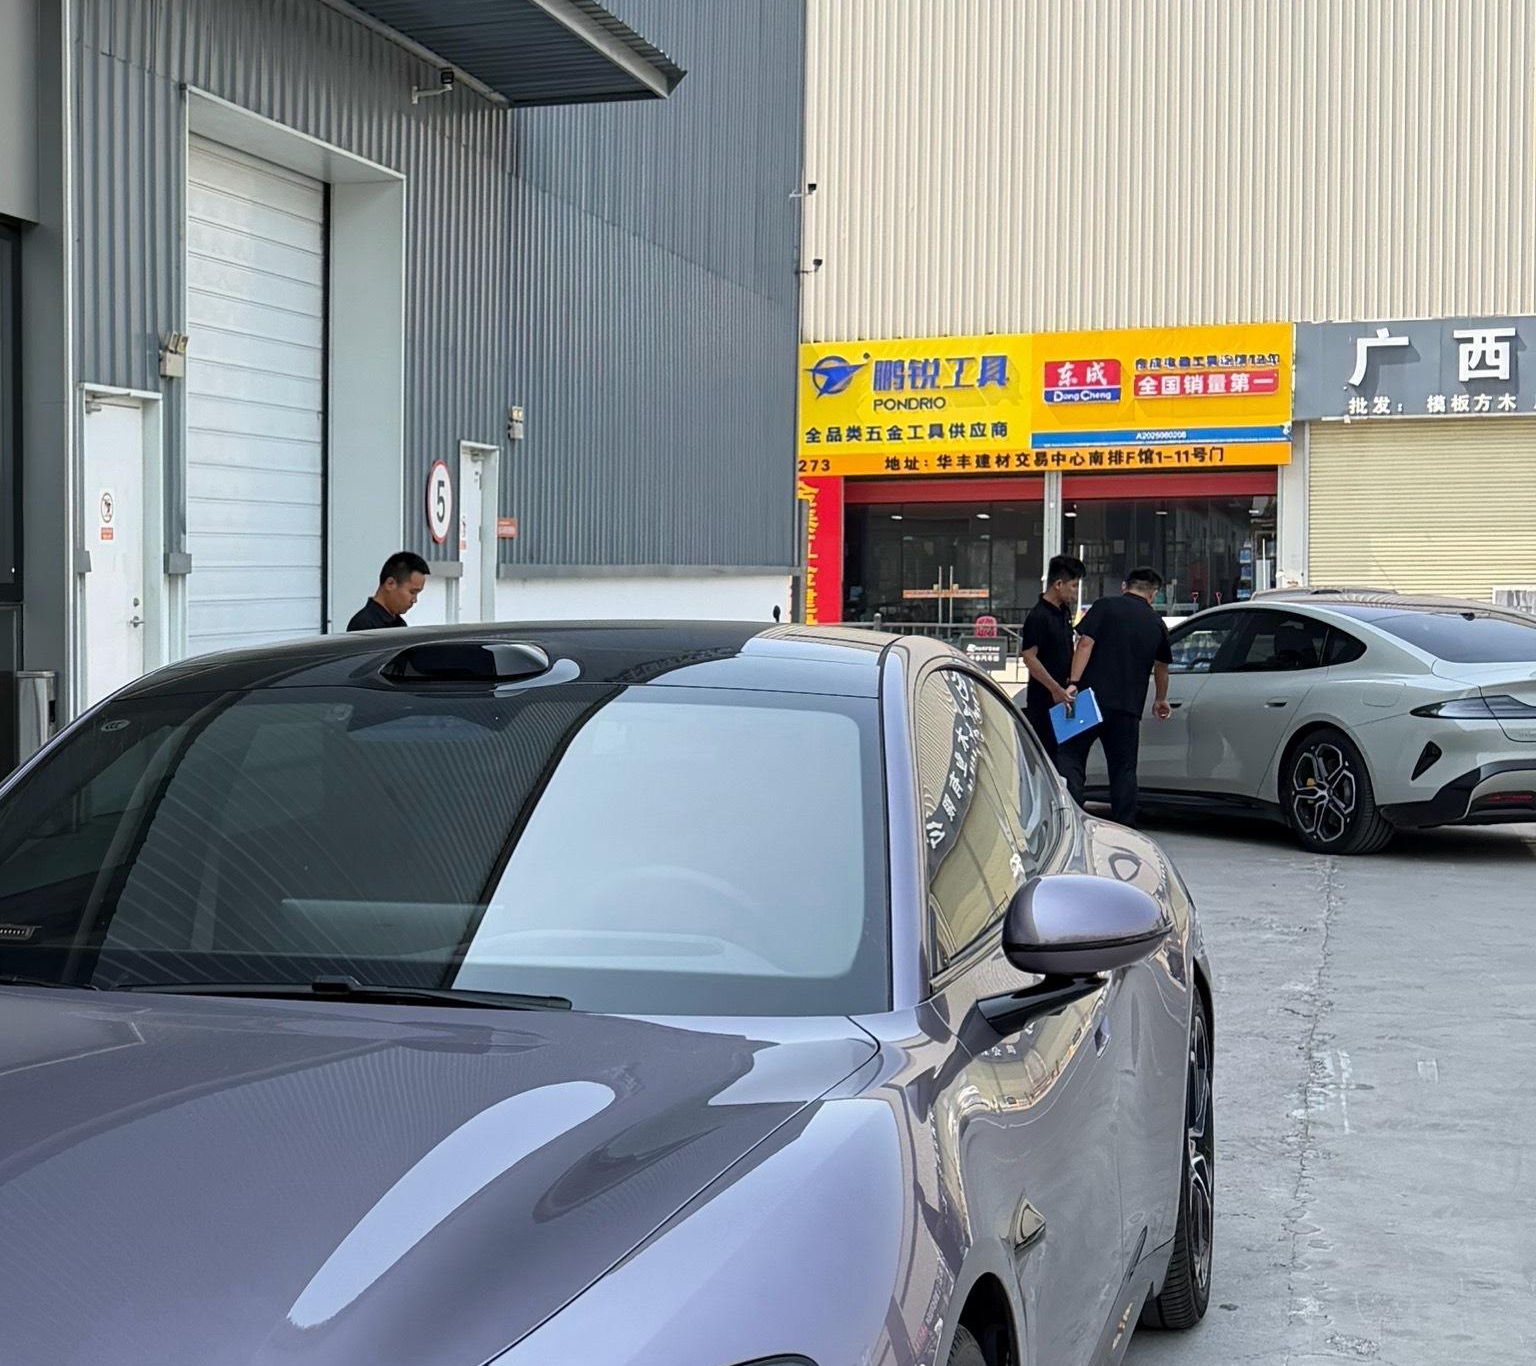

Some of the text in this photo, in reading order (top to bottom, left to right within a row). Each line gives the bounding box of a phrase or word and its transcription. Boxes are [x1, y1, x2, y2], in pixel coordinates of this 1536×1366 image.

[1348, 327, 1516, 387] 广西
[1057, 362, 1108, 387] 东成
[1137, 372, 1275, 396] 全国销量第一
[873, 396, 947, 412] PONDRIO
[805, 421, 1008, 444] 全品类五金工具供应商
[436, 480, 446, 523] 5
